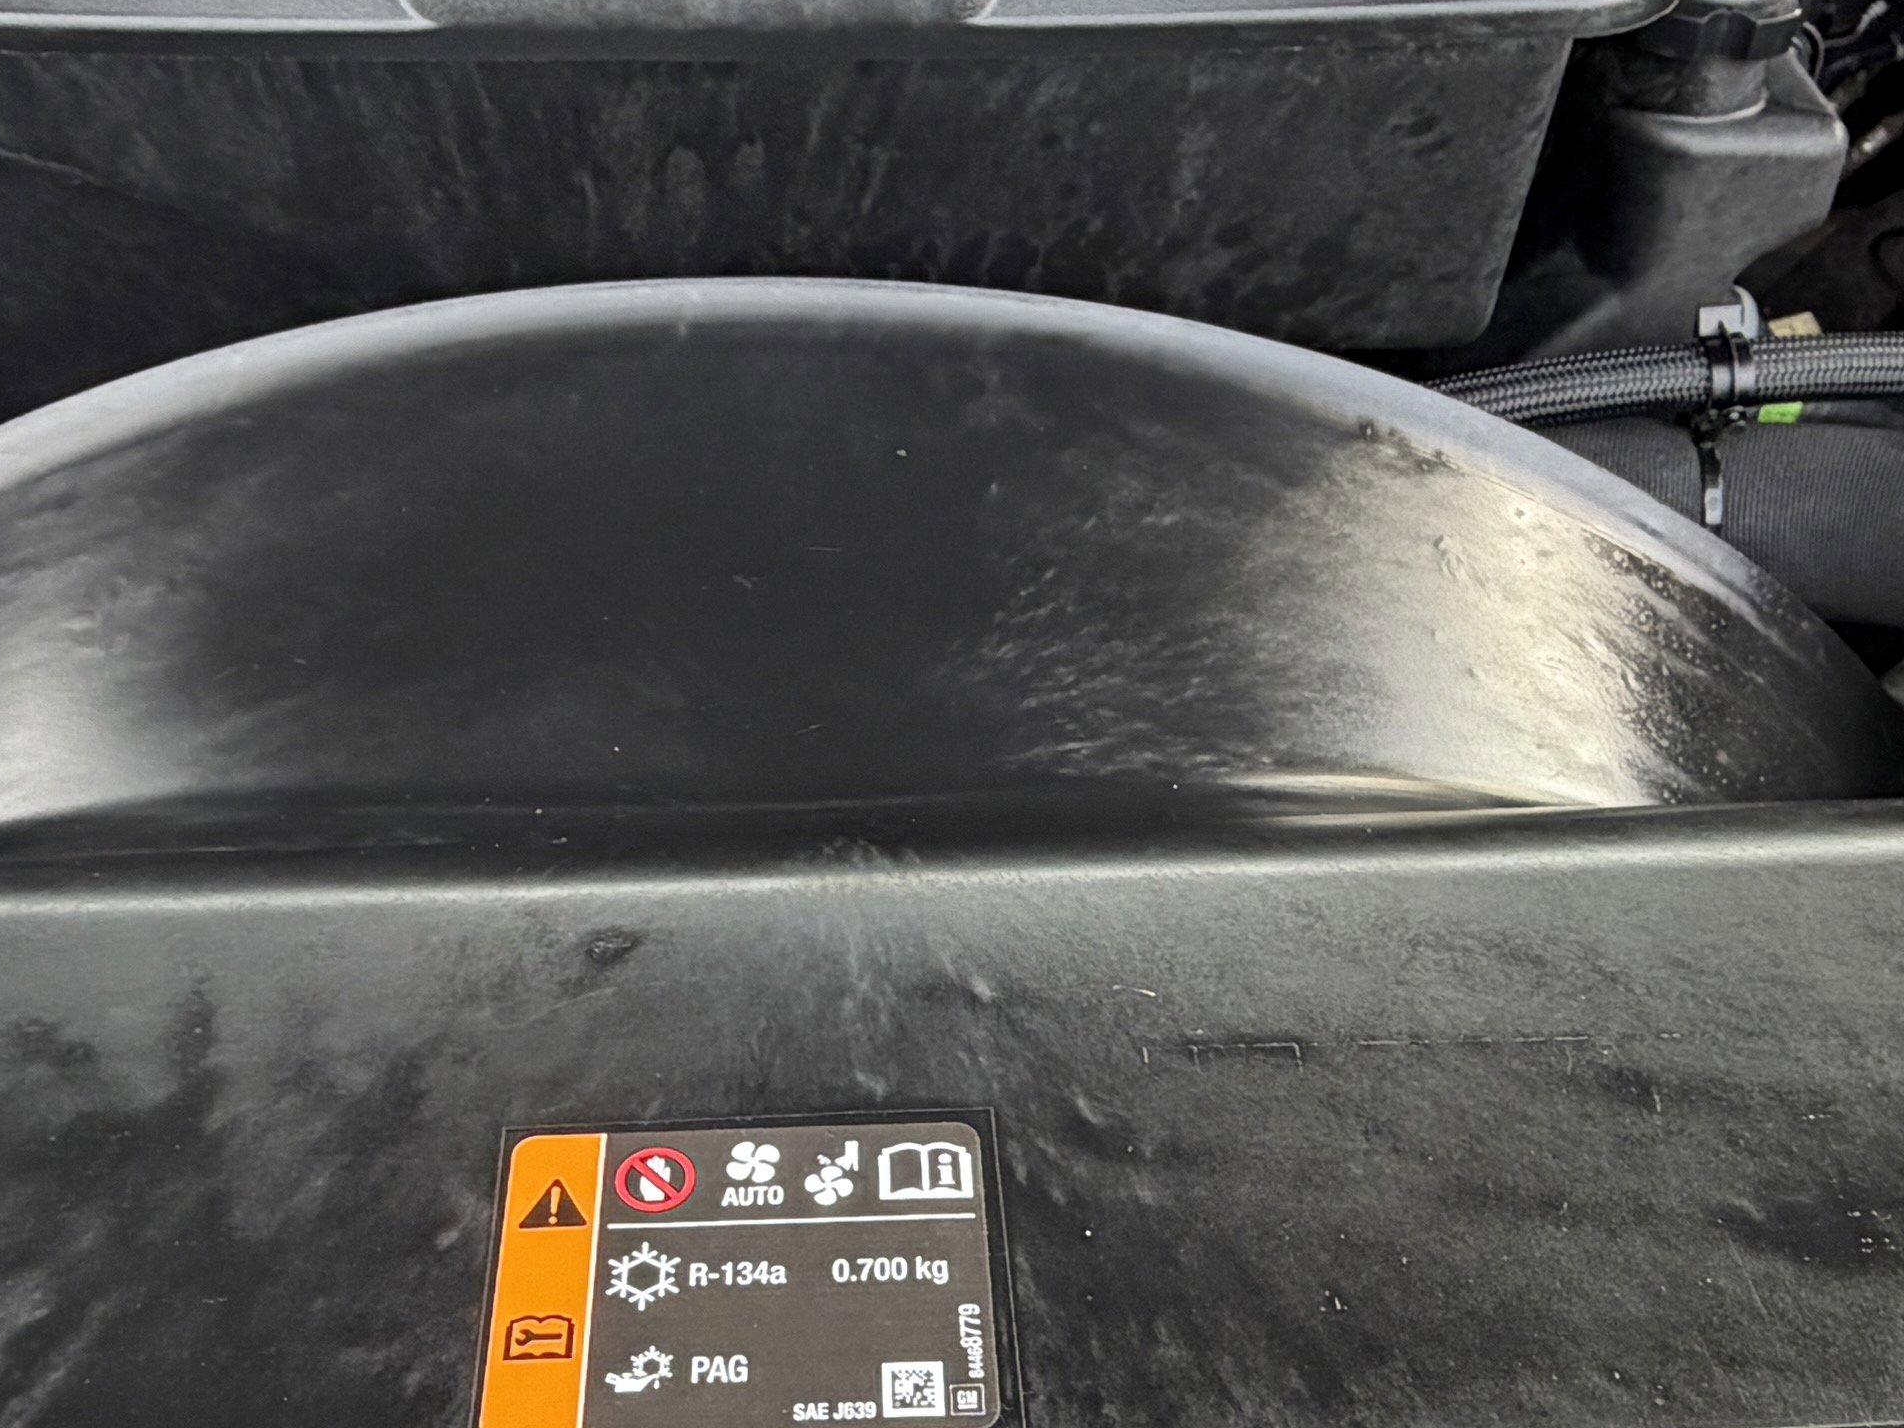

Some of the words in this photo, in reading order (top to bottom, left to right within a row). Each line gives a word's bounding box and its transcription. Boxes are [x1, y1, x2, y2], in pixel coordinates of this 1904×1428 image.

[720, 1185, 785, 1208] AUTO
[688, 1260, 788, 1287] R-134a
[831, 1256, 908, 1283] 0.700
[914, 1255, 950, 1285] kg
[690, 1354, 749, 1384] PAG
[792, 1402, 830, 1422] SAE
[832, 1400, 877, 1421] J639
[954, 1388, 981, 1412] GM
